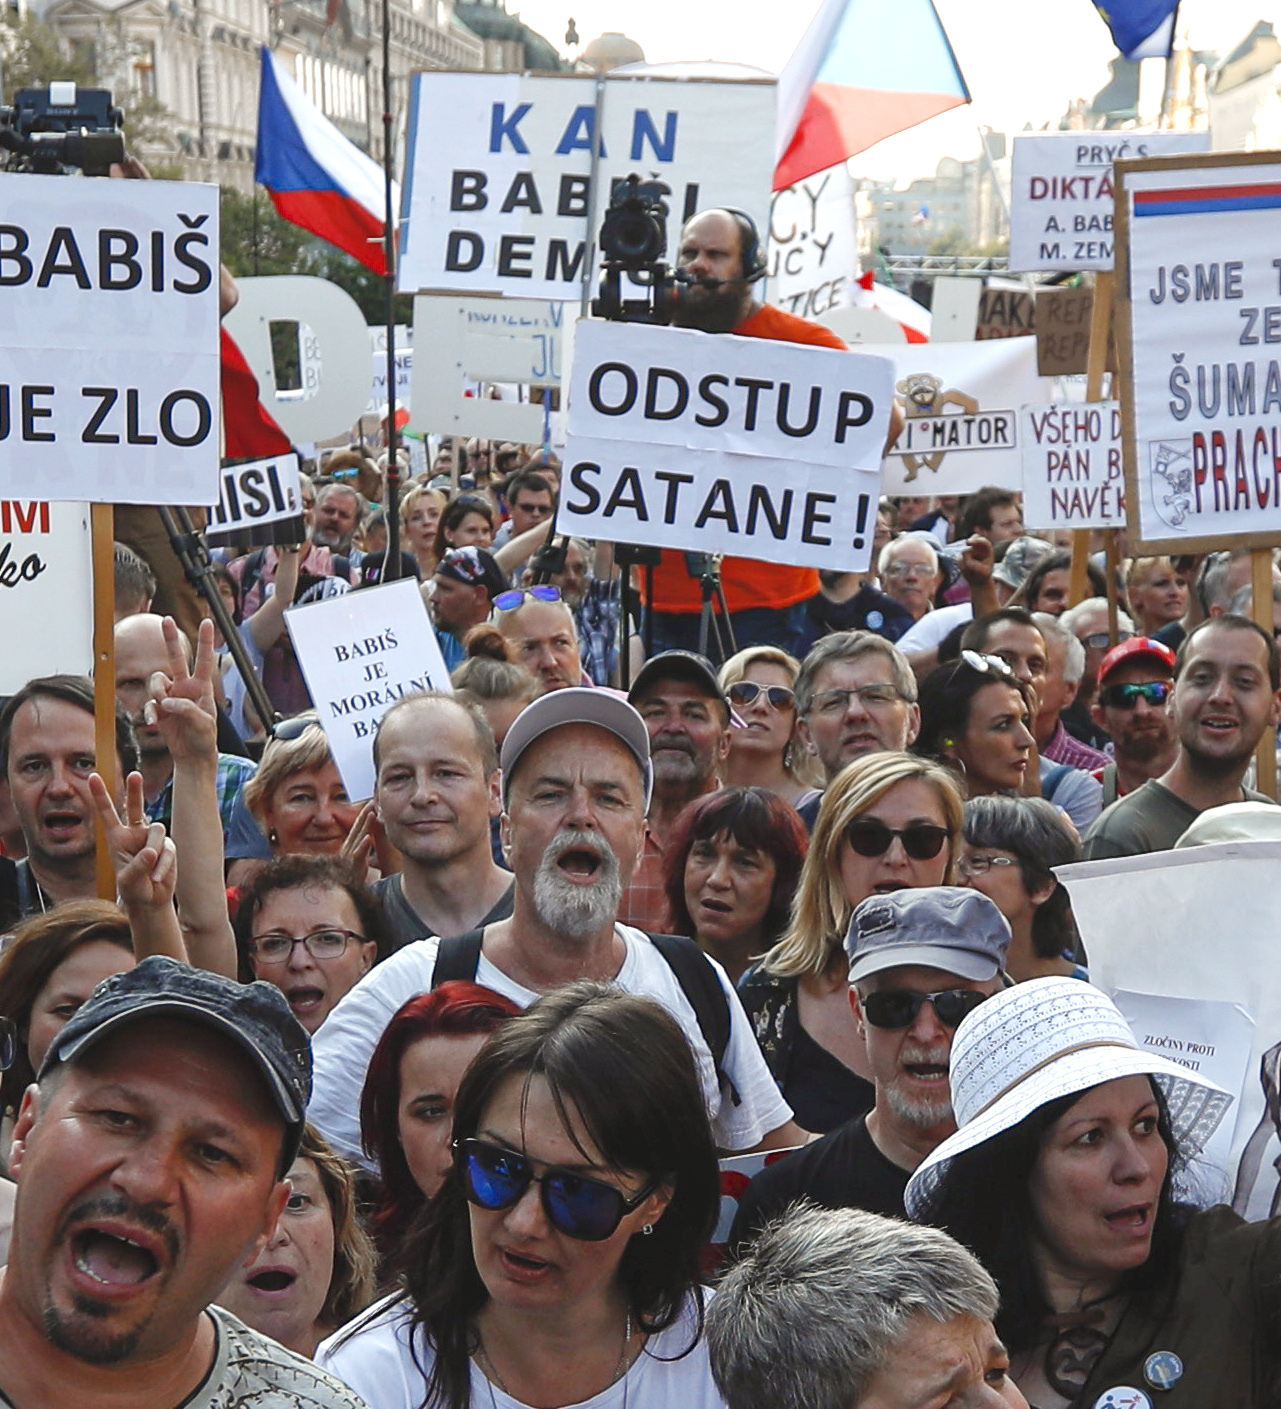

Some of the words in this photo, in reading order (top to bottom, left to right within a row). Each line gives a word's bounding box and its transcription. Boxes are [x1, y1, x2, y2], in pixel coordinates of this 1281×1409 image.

[488, 101, 679, 163] KAN
[1149, 261, 1245, 305] JSME
[81, 387, 212, 447] ZLO
[589, 362, 875, 444] ODSTUP
[1030, 404, 1101, 444] VŠEHO
[1047, 443, 1091, 483] PÁN
[566, 461, 837, 546] SATANE
[853, 494, 870, 550] !
[333, 628, 399, 663] BABIŠ
[363, 662, 389, 682] JE
[1186, 1041, 1216, 1057] PROTI
